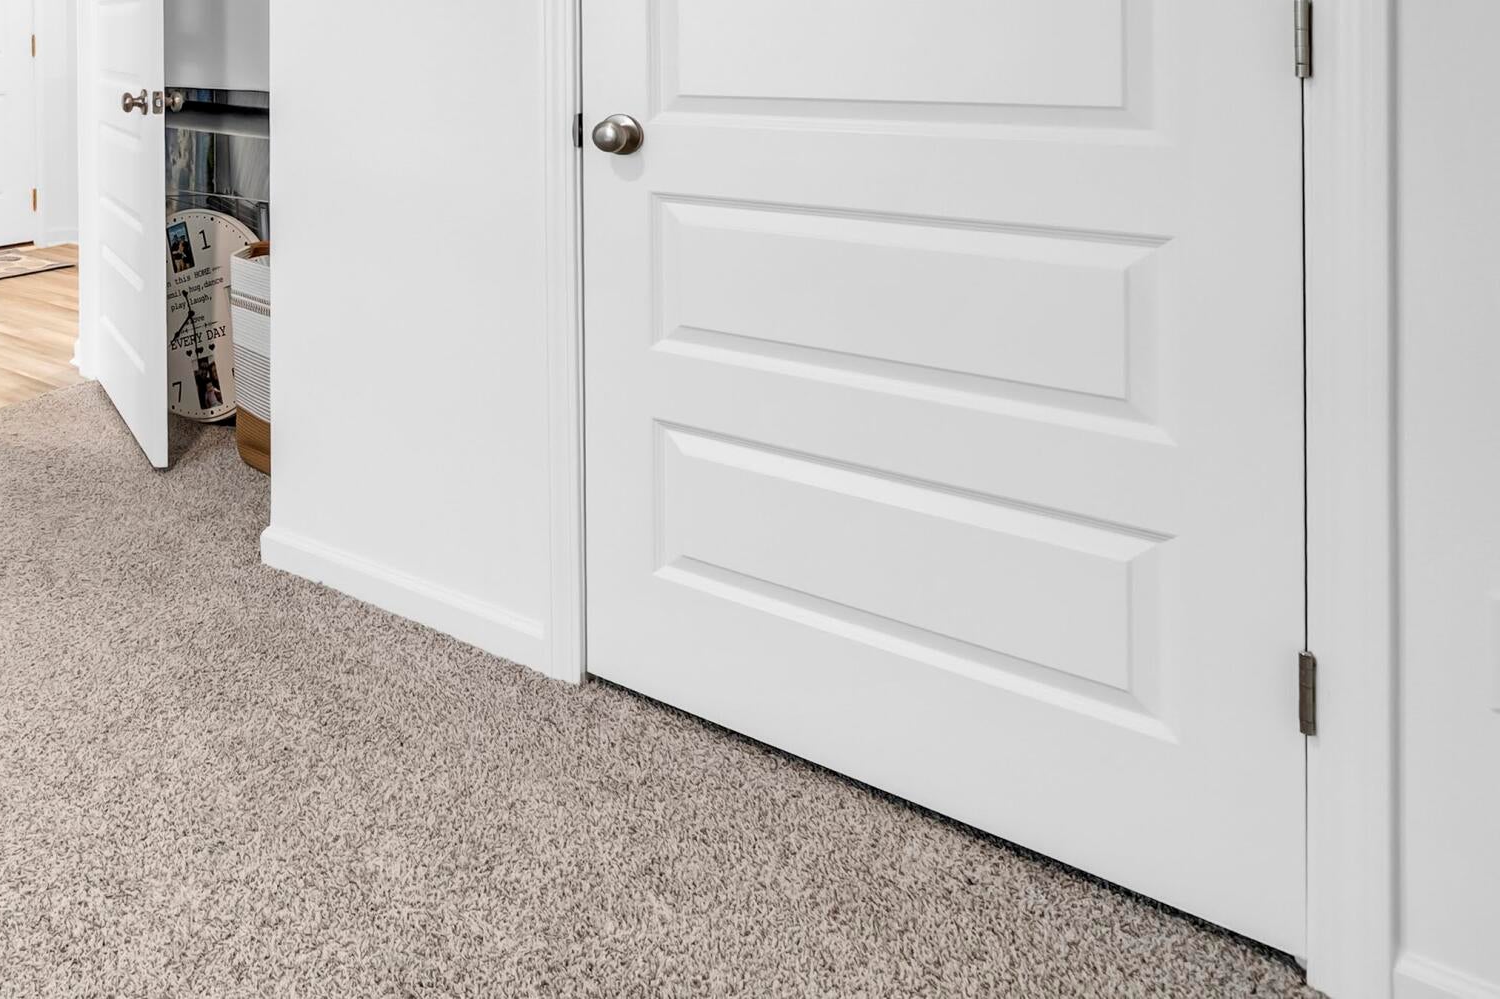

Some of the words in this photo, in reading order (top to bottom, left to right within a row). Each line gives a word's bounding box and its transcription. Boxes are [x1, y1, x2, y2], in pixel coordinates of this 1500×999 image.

[198, 229, 211, 250] 1
[174, 275, 191, 285] this
[193, 267, 212, 278] HOME
[170, 301, 187, 313] play
[170, 331, 203, 351] EVERY
[206, 325, 227, 341] DAY
[171, 381, 182, 402] 7
